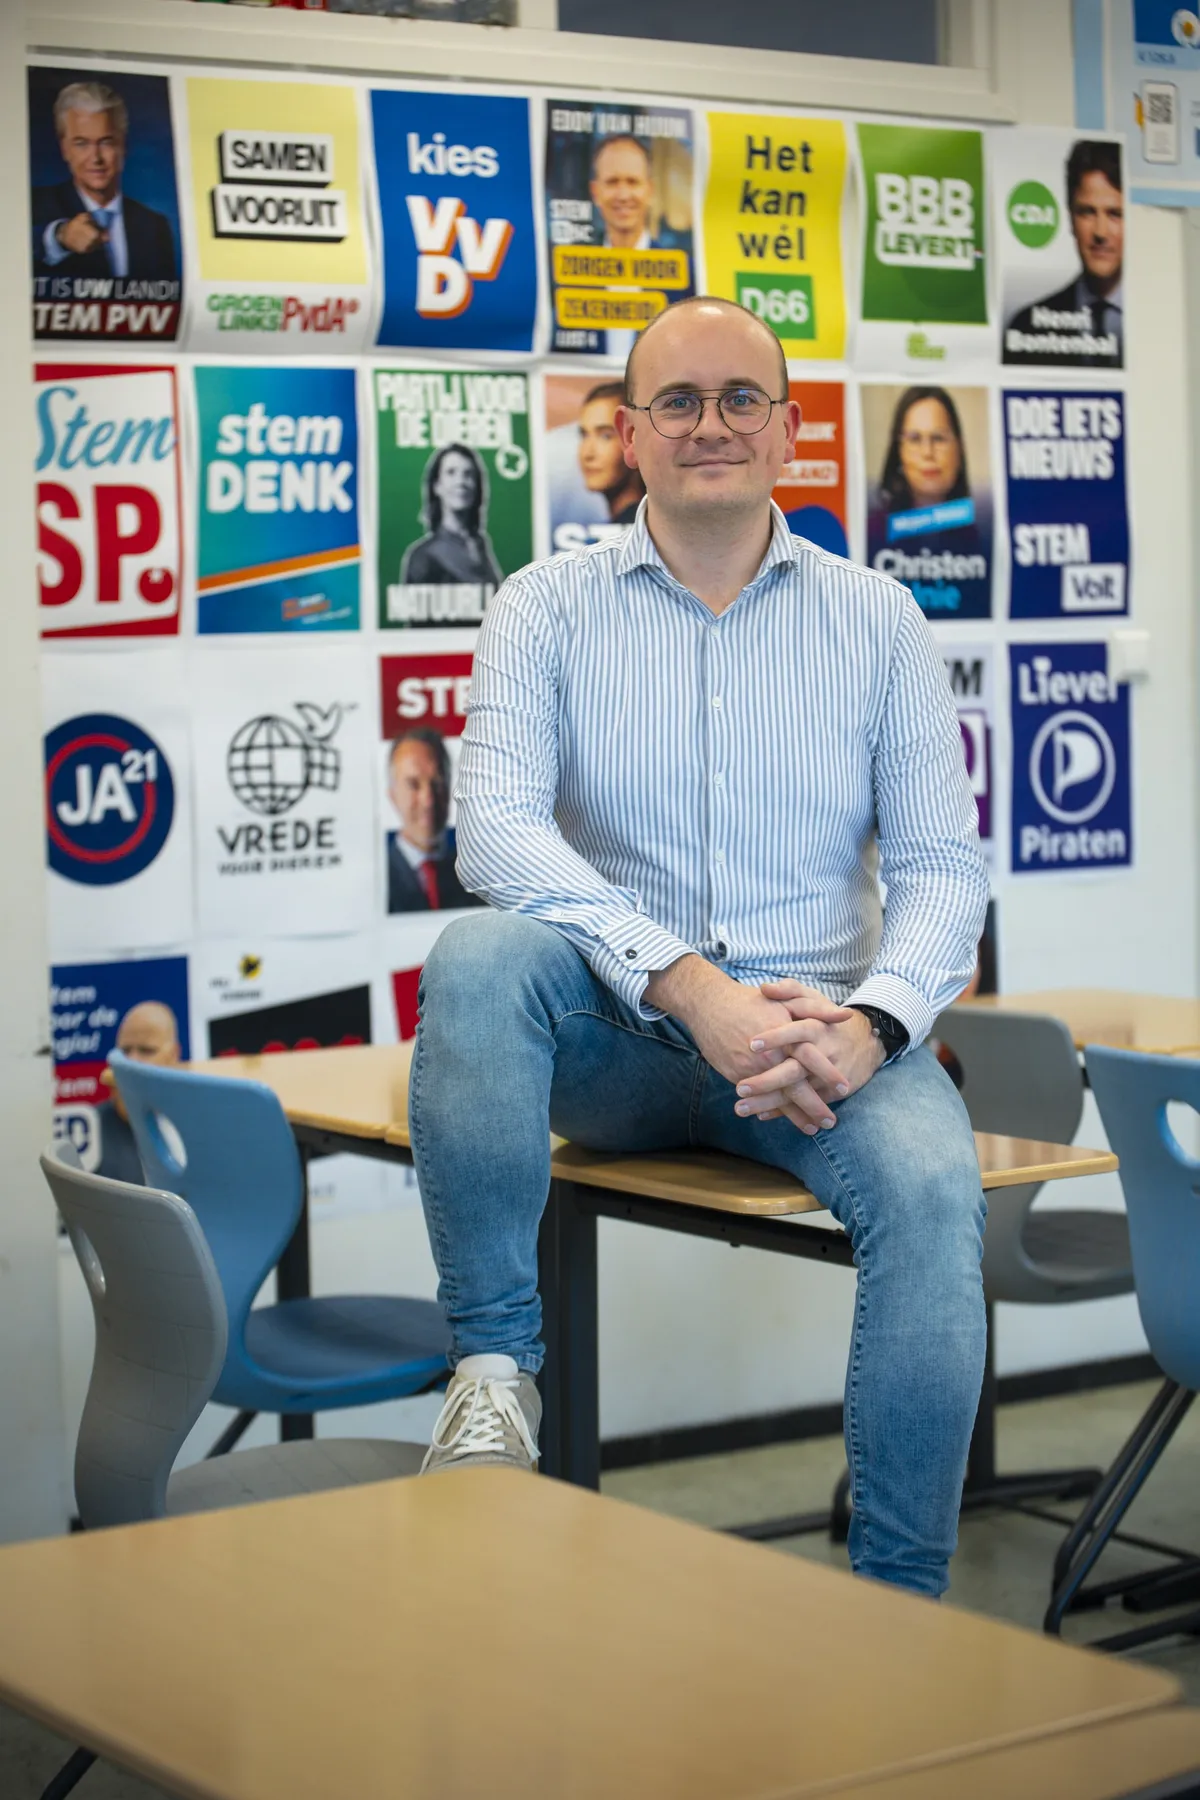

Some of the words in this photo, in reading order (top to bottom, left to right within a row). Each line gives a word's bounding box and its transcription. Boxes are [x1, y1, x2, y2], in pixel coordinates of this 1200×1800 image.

[231, 138, 328, 173] SAMEN
[406, 132, 500, 179] kies
[745, 135, 814, 174] Het
[224, 195, 340, 227] VOORUIT
[739, 181, 807, 218] kan
[874, 172, 975, 226] BBB
[51, 277, 71, 298] IS
[72, 278, 114, 298] UW
[740, 286, 810, 324] D66
[105, 304, 174, 333] PVV
[34, 386, 178, 472] Stem
[216, 402, 344, 456] stem
[396, 411, 430, 448] DE
[1007, 397, 1060, 438] DOE
[1062, 397, 1122, 440] IETS
[1009, 438, 1115, 481] NIEUWS
[205, 460, 354, 513] DENK
[554, 522, 623, 550] ST
[1013, 522, 1091, 567] STEM
[874, 547, 987, 580] Christen
[903, 578, 962, 611] nie
[1071, 571, 1116, 601] Volt
[217, 817, 337, 855] VREDE
[1019, 824, 1127, 865] Piraten
[88, 1005, 119, 1029] de
